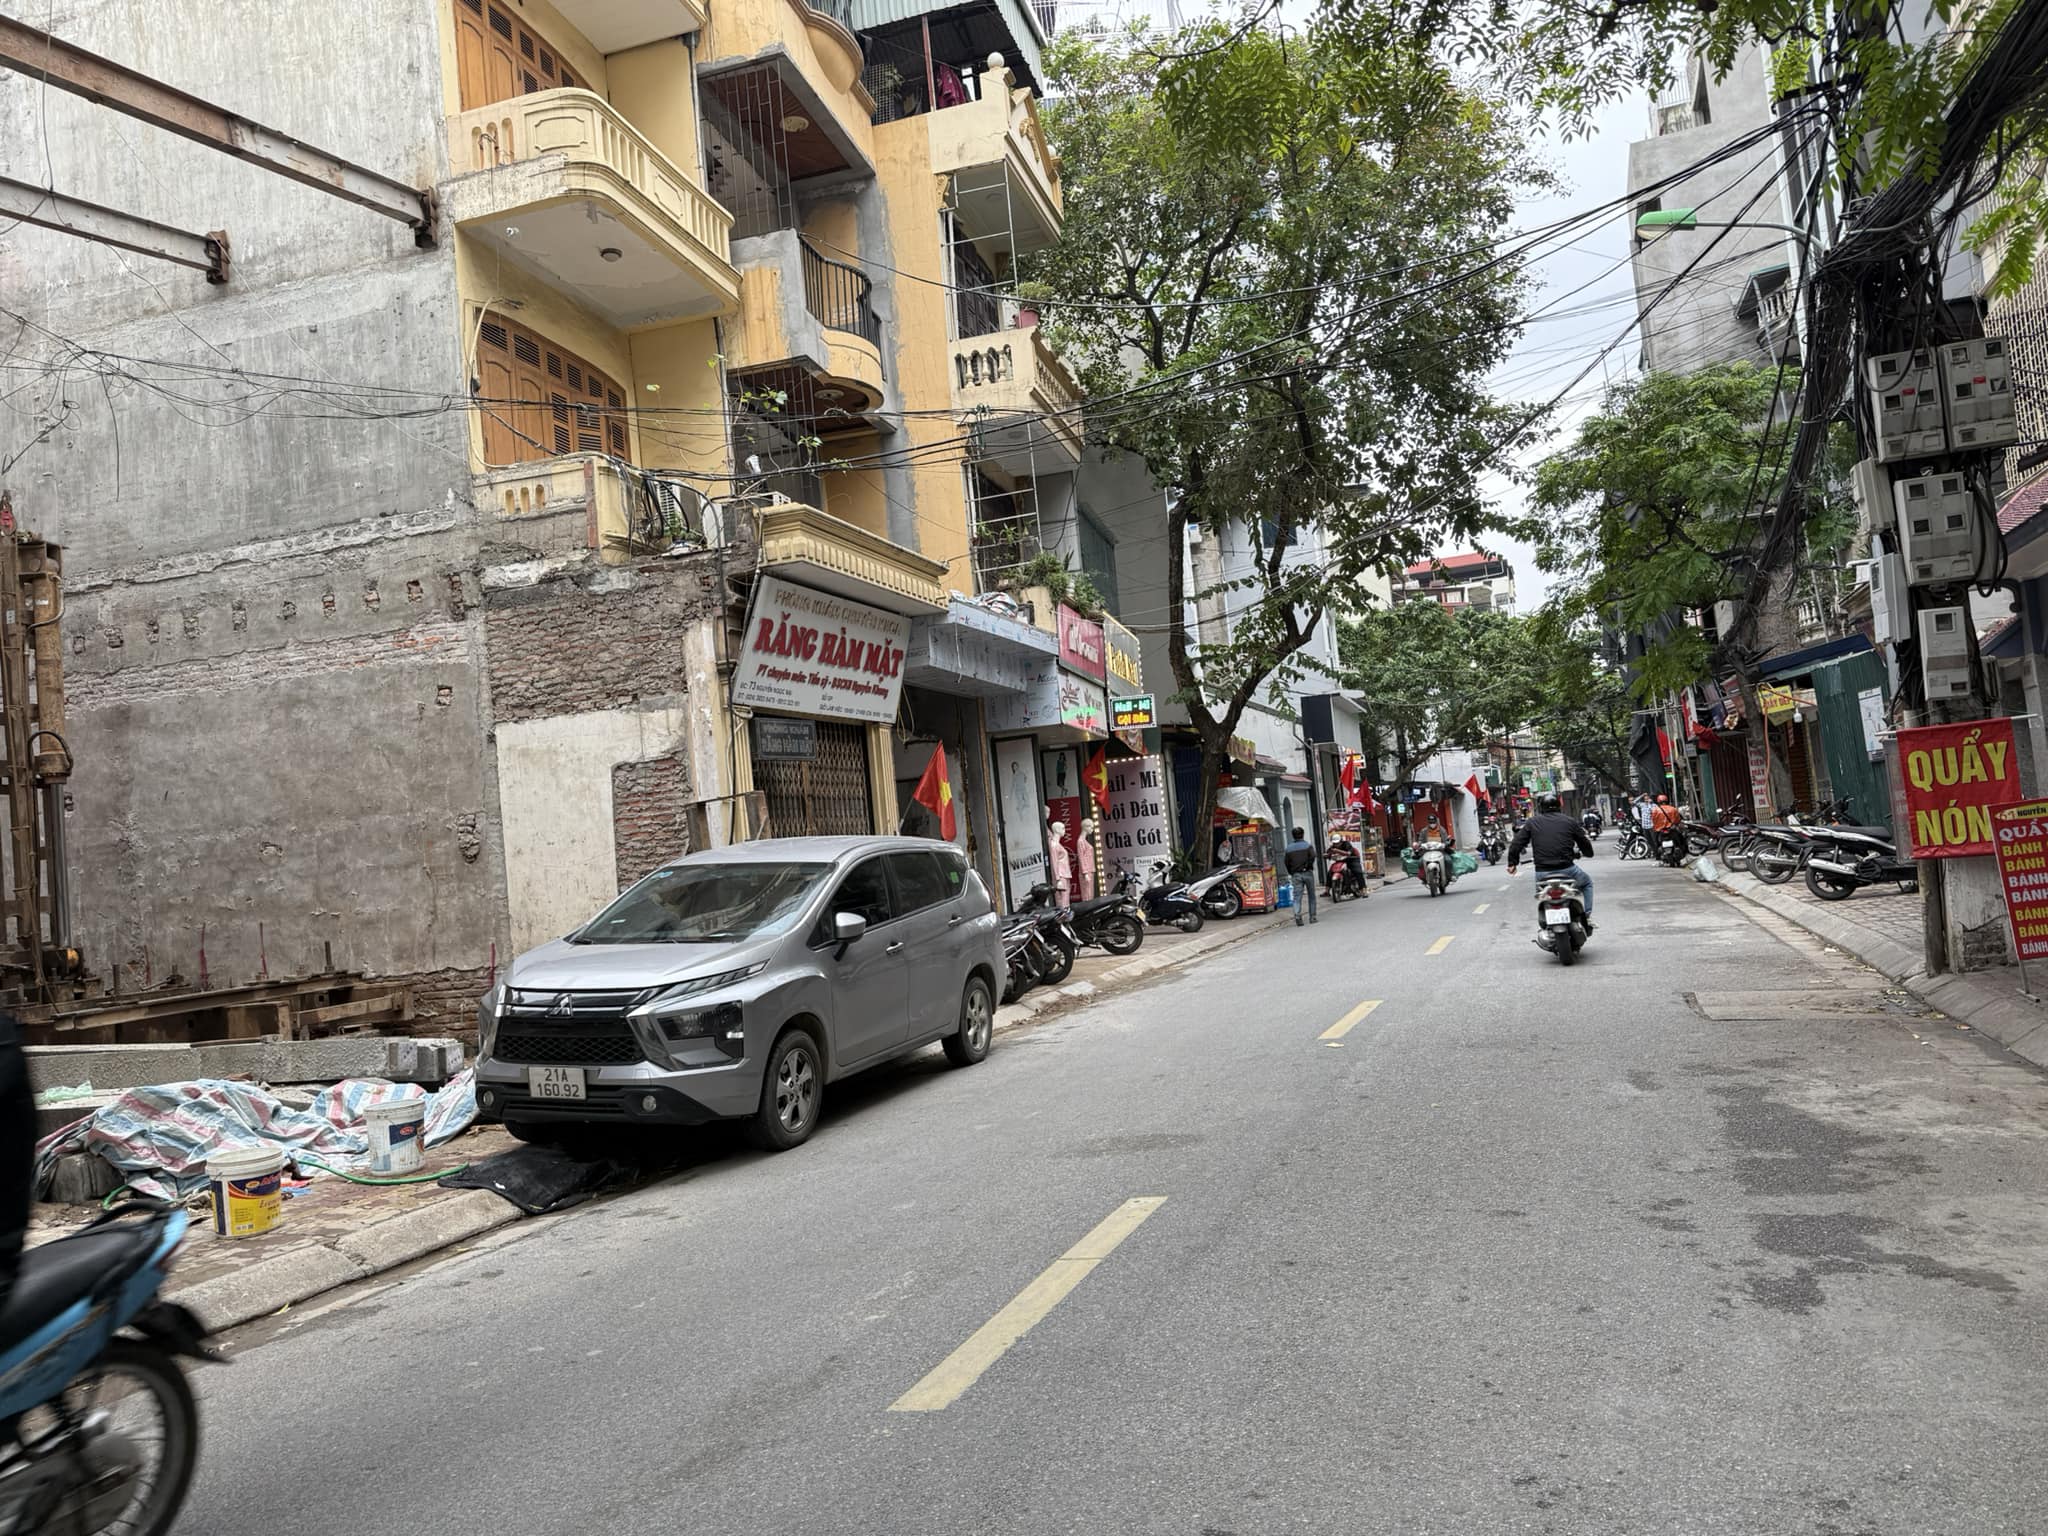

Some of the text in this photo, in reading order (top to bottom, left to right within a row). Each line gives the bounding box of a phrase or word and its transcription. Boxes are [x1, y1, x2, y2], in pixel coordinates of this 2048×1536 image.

[753, 611, 904, 683] RĂNG HÀM MẶT
[756, 663, 769, 676] PT
[1907, 728, 2007, 792] QUẨY
[1107, 774, 1126, 793] ail
[1139, 770, 1158, 789] Mi
[1130, 798, 1160, 822] Đầu
[1916, 800, 1993, 847] NÓN
[1104, 827, 1163, 849] Chà Gót
[2002, 841, 2043, 857] BÁNH
[2005, 857, 2046, 872] BÁNH
[544, 1068, 569, 1082] 21A
[537, 1083, 580, 1097] 160.92
